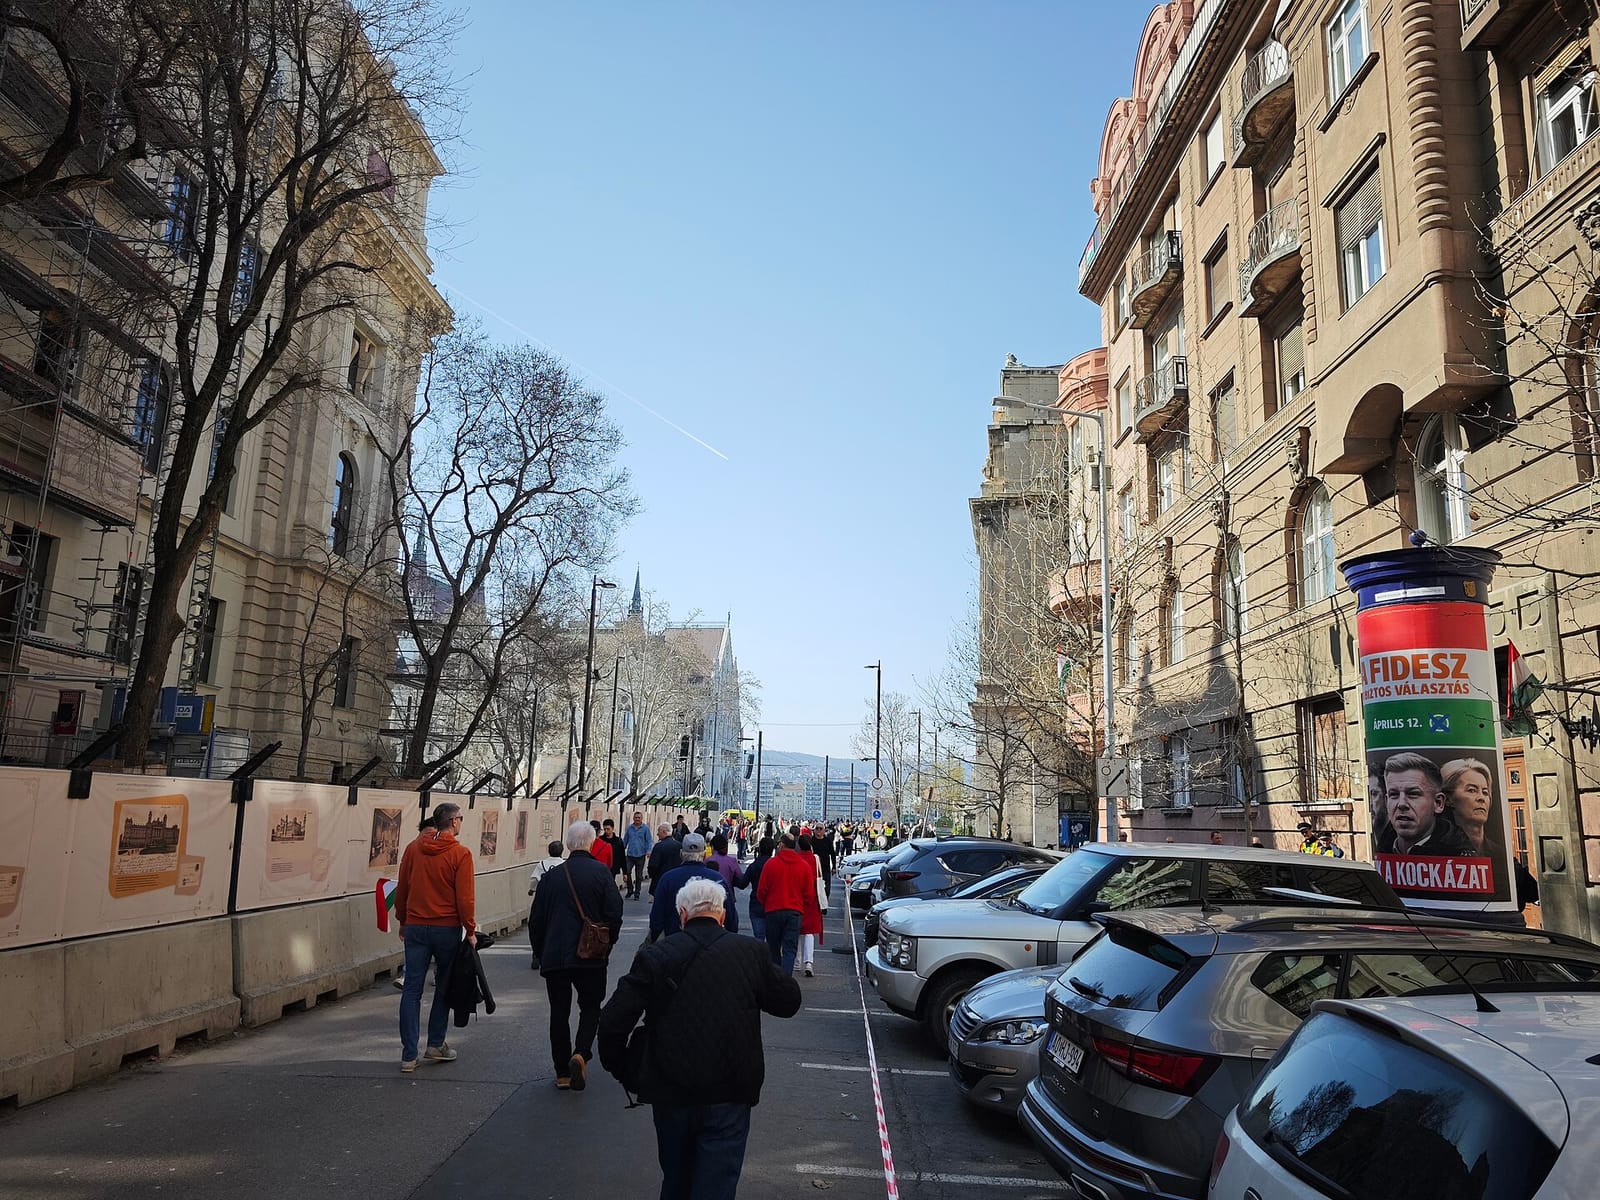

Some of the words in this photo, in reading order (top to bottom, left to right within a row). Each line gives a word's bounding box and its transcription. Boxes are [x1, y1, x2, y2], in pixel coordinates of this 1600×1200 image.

[1369, 653, 1469, 684] FIDESZ
[1395, 680, 1470, 696] VÁLASZTÁS
[1373, 718, 1404, 731] ÁPRILIS
[1407, 718, 1423, 728] 12.
[1385, 861, 1393, 886] A
[1396, 859, 1489, 890] KOCKÁZAT
